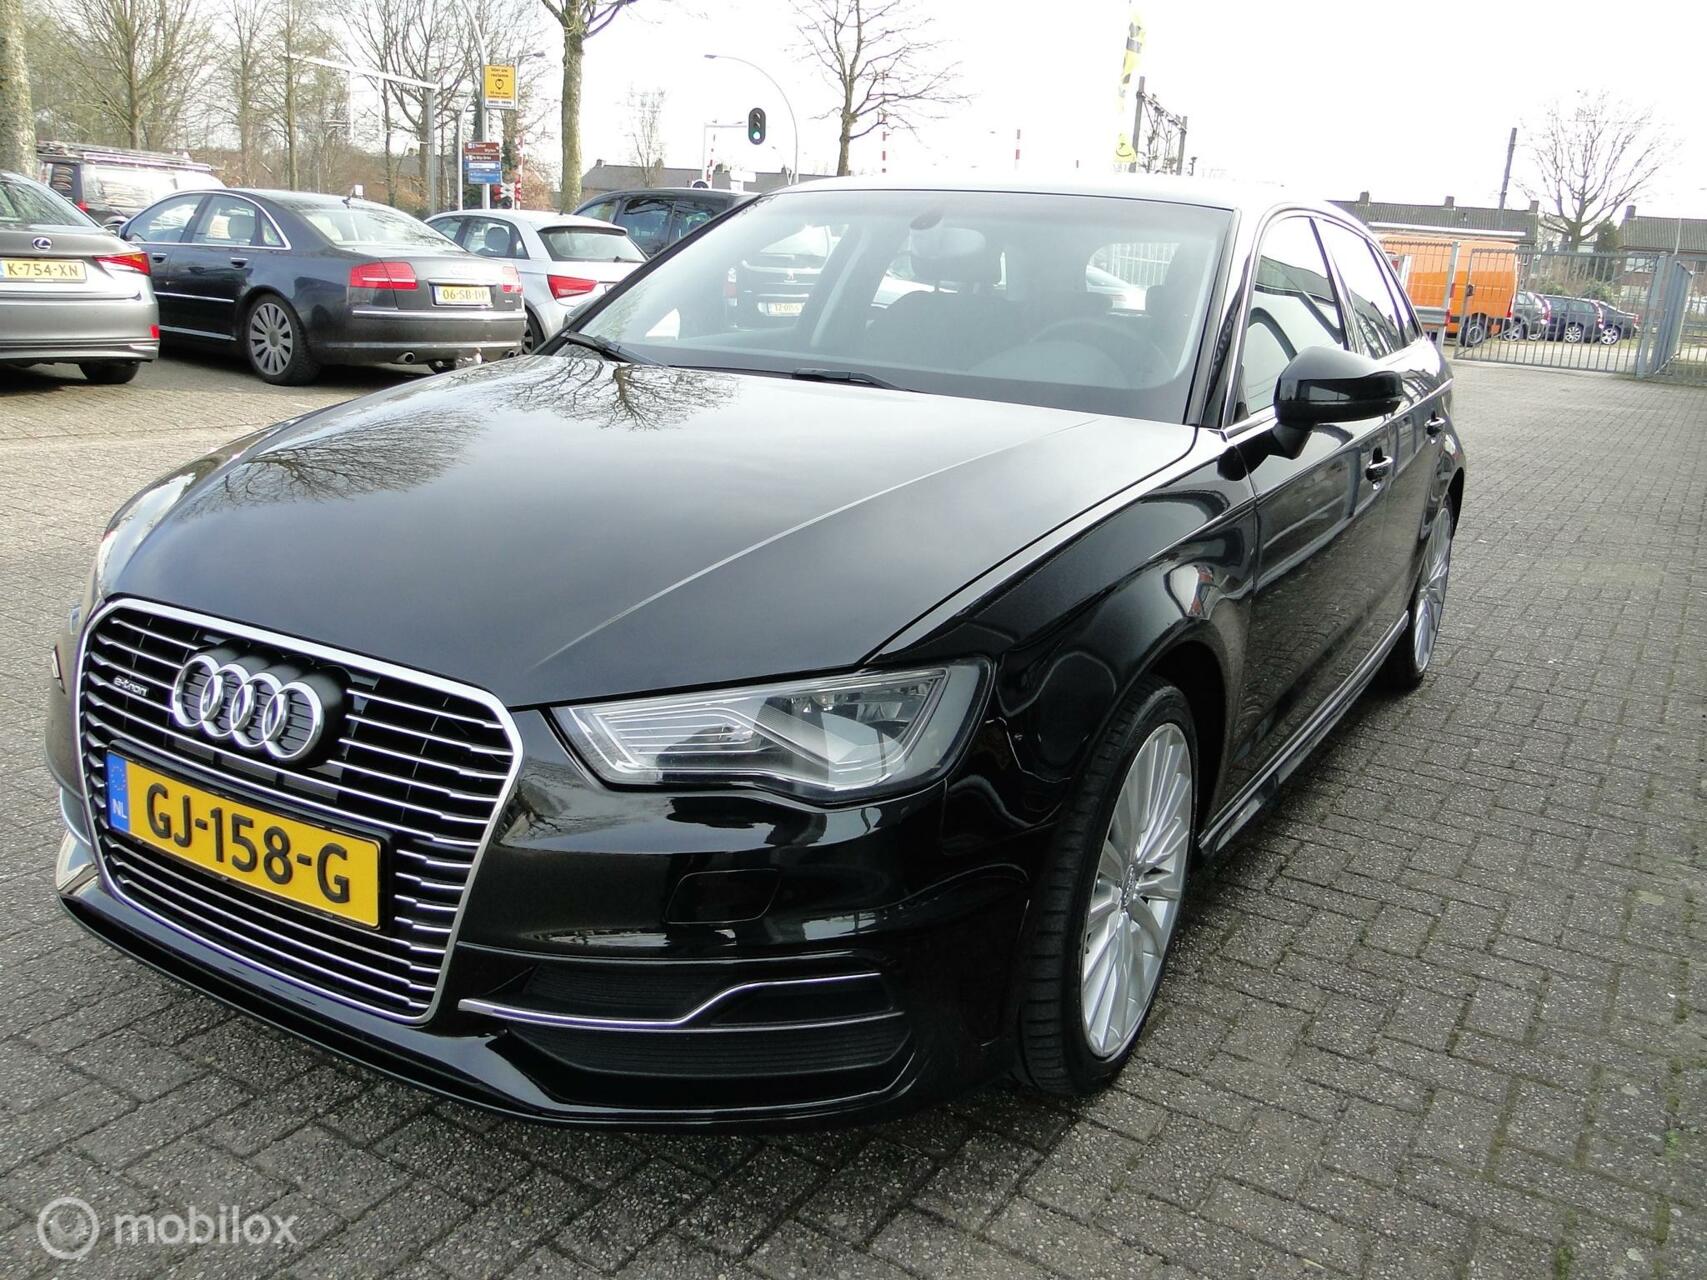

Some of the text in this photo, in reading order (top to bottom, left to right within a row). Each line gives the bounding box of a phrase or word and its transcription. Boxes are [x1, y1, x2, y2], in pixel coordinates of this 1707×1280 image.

[7, 263, 79, 276] K-754-XN
[114, 677, 147, 696] e-tron
[112, 782, 350, 904] NL GJ-158-G
